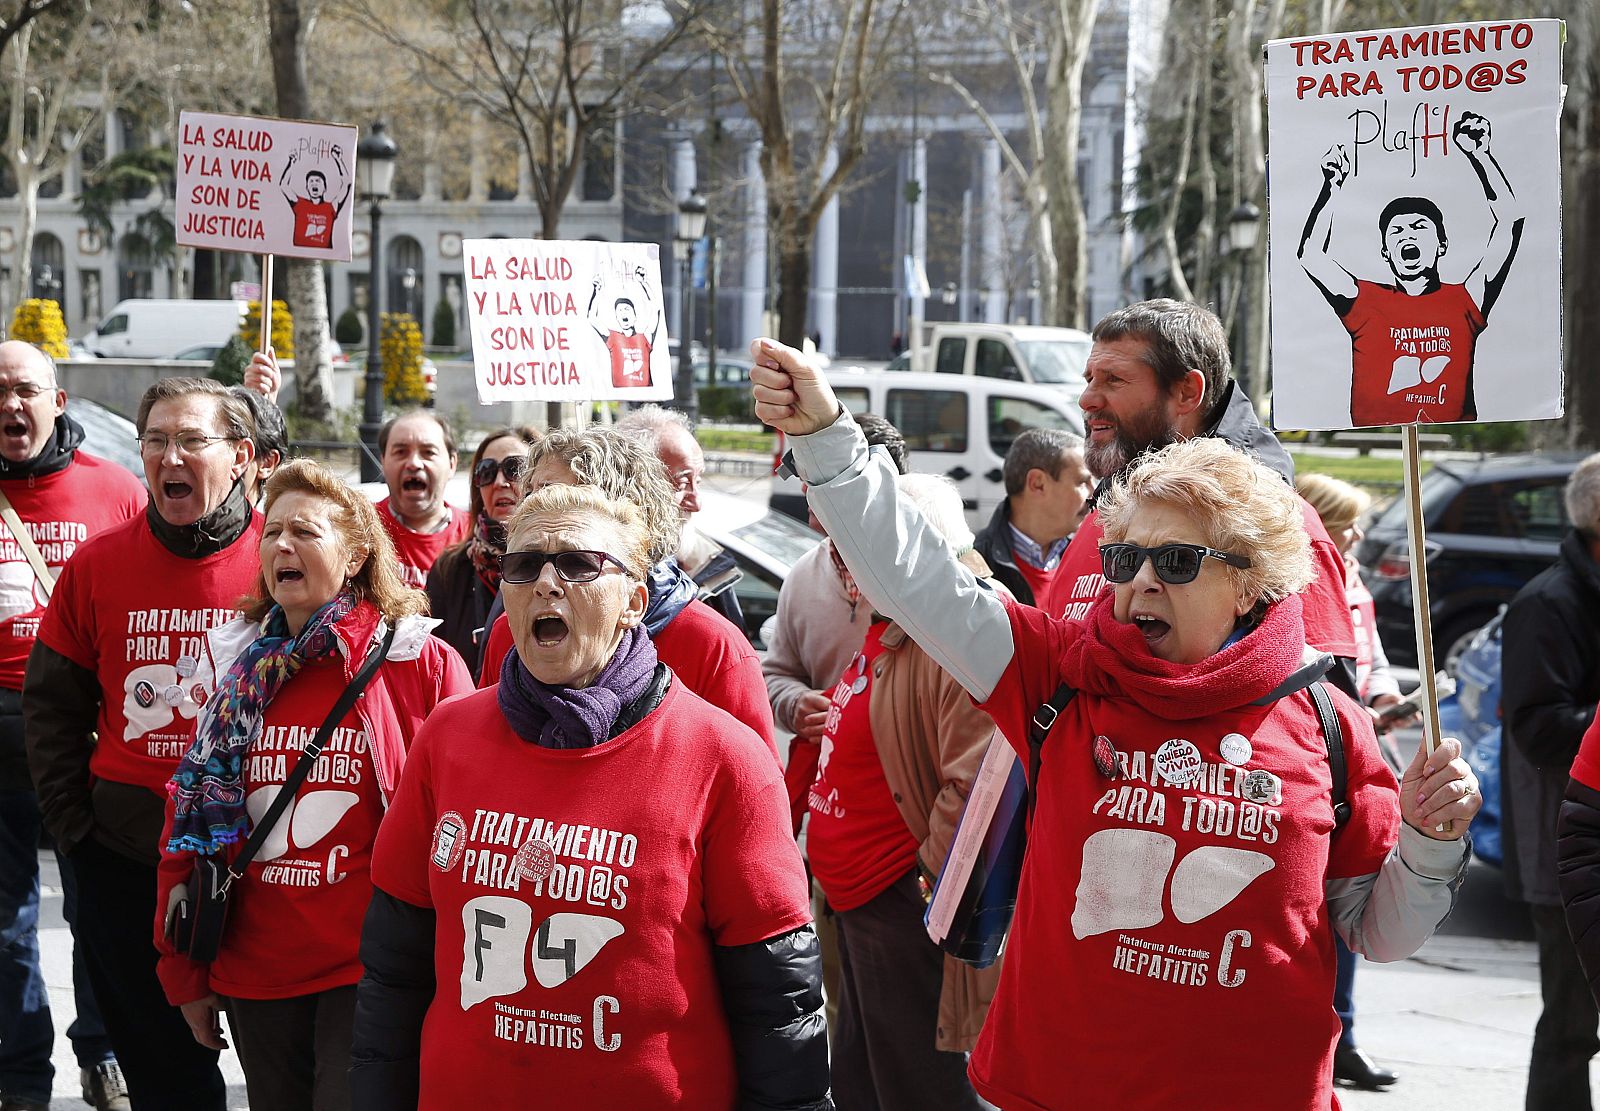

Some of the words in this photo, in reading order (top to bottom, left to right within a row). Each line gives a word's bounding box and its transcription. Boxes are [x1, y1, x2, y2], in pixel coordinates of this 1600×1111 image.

[1290, 23, 1533, 66] TRATAMIENTO
[1297, 70, 1384, 100] PARA
[1397, 59, 1528, 92] TOD@S
[183, 124, 205, 146] LA
[212, 128, 273, 152] SALUD
[184, 154, 194, 174] Y
[200, 156, 222, 178] LA
[231, 159, 272, 182] VIDA
[192, 185, 230, 208] SON
[237, 188, 260, 210] DE
[184, 212, 265, 240] JUSTICIA
[470, 256, 496, 280] LA
[506, 256, 572, 280] SALUD
[474, 292, 487, 316] Y
[496, 292, 522, 316] LA
[530, 292, 577, 316] VIDA
[490, 327, 534, 350] SON
[543, 327, 570, 350] DE
[1390, 326, 1450, 340] TRATAMIENTO
[1420, 338, 1451, 352] TOD@S
[486, 362, 580, 386] JUSTICIA
[1438, 384, 1446, 404] C
[126, 636, 170, 662] PARA
[1164, 740, 1182, 750] ME
[242, 755, 286, 783] PARA
[298, 754, 362, 784] OD@S
[1092, 786, 1166, 826] PARA
[1182, 797, 1281, 844] TOD@S
[470, 809, 638, 868] TRATAMIENTO
[262, 866, 320, 886] HEPATITIS
[326, 845, 348, 884] C
[462, 849, 520, 892] PARA
[518, 850, 550, 868] MUNDO
[518, 858, 526, 866] YO
[530, 862, 548, 876] TUVE
[1112, 946, 1208, 986] HEPATITIS
[1218, 930, 1252, 988] C
[1118, 934, 1164, 952] Plataforma
[1168, 944, 1210, 960] Afectad@s
[495, 1002, 536, 1018] Plataforma
[540, 1010, 582, 1024] Afectad@s
[495, 1014, 583, 1050] HEPATITIS
[593, 995, 622, 1052] C
